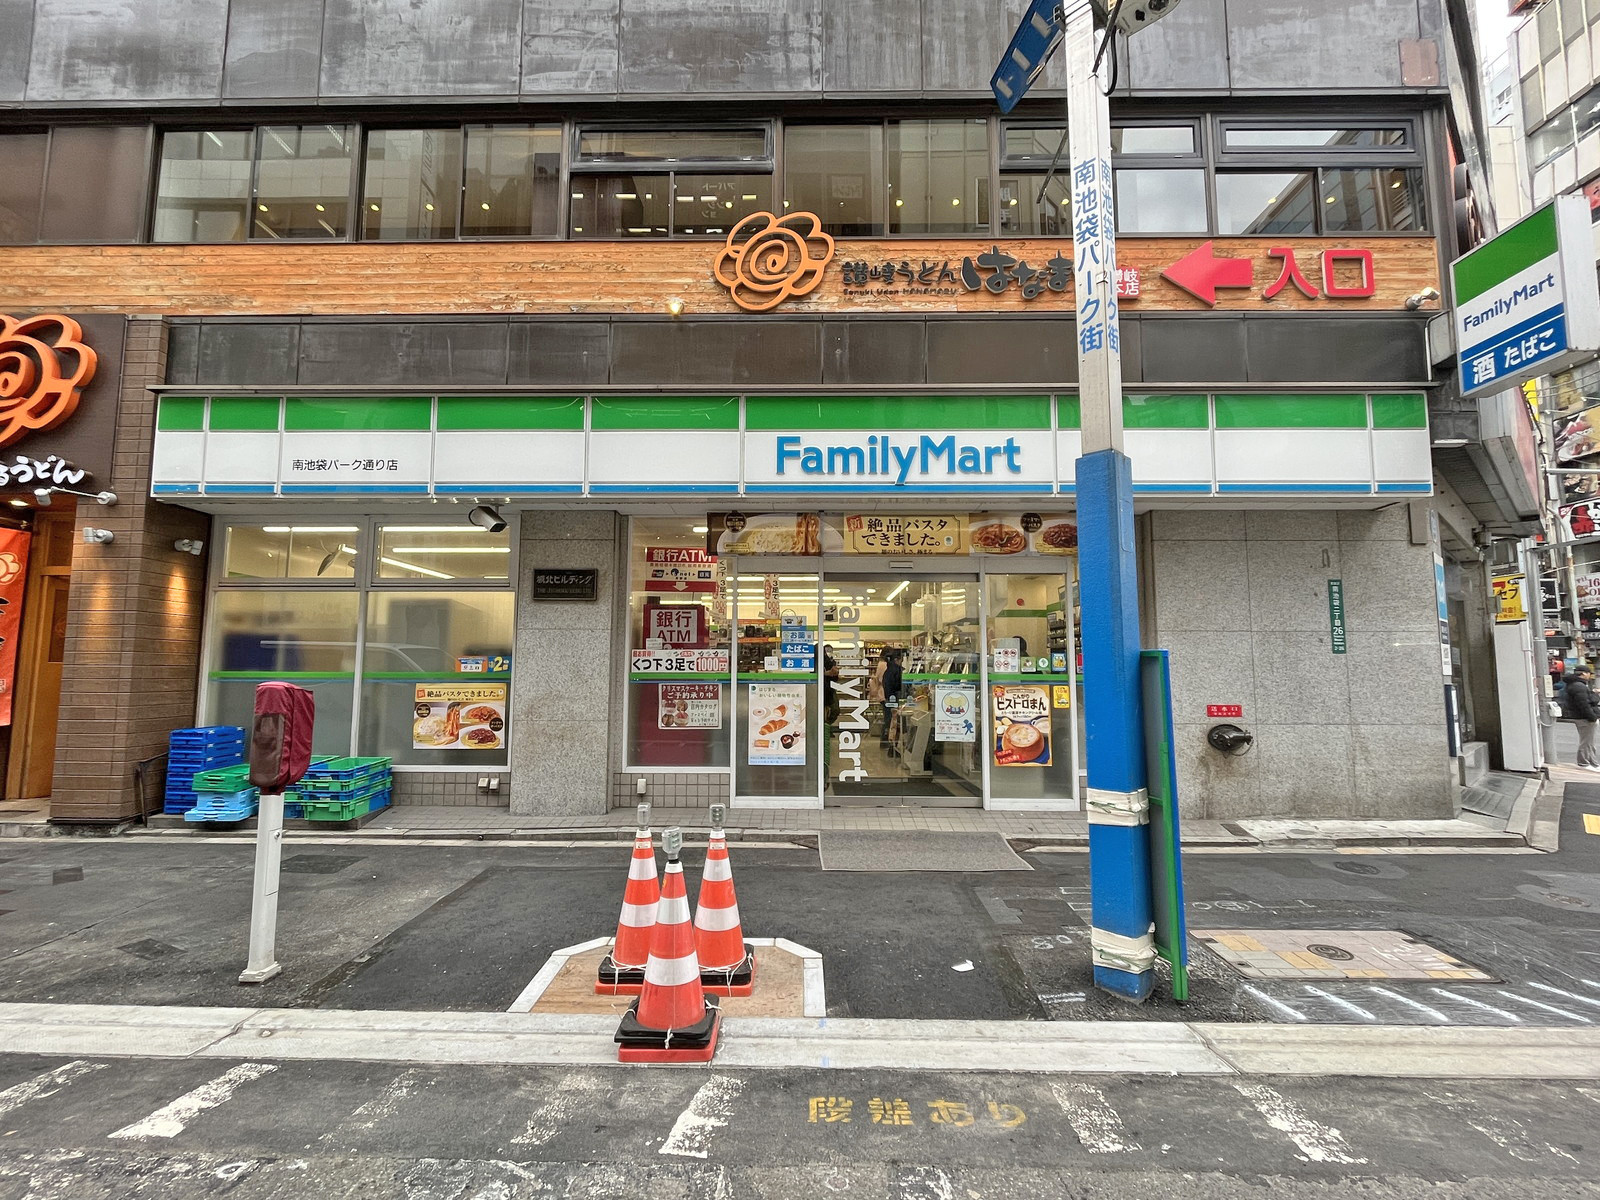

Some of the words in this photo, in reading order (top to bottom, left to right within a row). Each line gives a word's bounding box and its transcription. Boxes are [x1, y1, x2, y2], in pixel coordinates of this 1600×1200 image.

[1073, 156, 1104, 355] 南池袋パーク街
[841, 260, 957, 286] 讃岐うどん
[960, 245, 1075, 300] はなま
[1262, 246, 1375, 300] 入口
[1463, 272, 1555, 333] FamilyMart
[1472, 351, 1497, 385] 酒
[1503, 327, 1557, 369] たばこ
[292, 459, 398, 471] 南池袋パーク通り店
[776, 434, 1022, 486] FamilyMart
[866, 517, 948, 533] 絶品パスタ
[861, 532, 941, 547] できました。
[652, 549, 712, 562] 銀行ATM
[656, 610, 692, 628] 銀行
[657, 629, 691, 642] ATM
[1332, 626, 1344, 635] 26
[786, 644, 810, 653] たばこ
[667, 691, 714, 699] ご予約承り中
[996, 696, 1047, 712] ビストロまん
